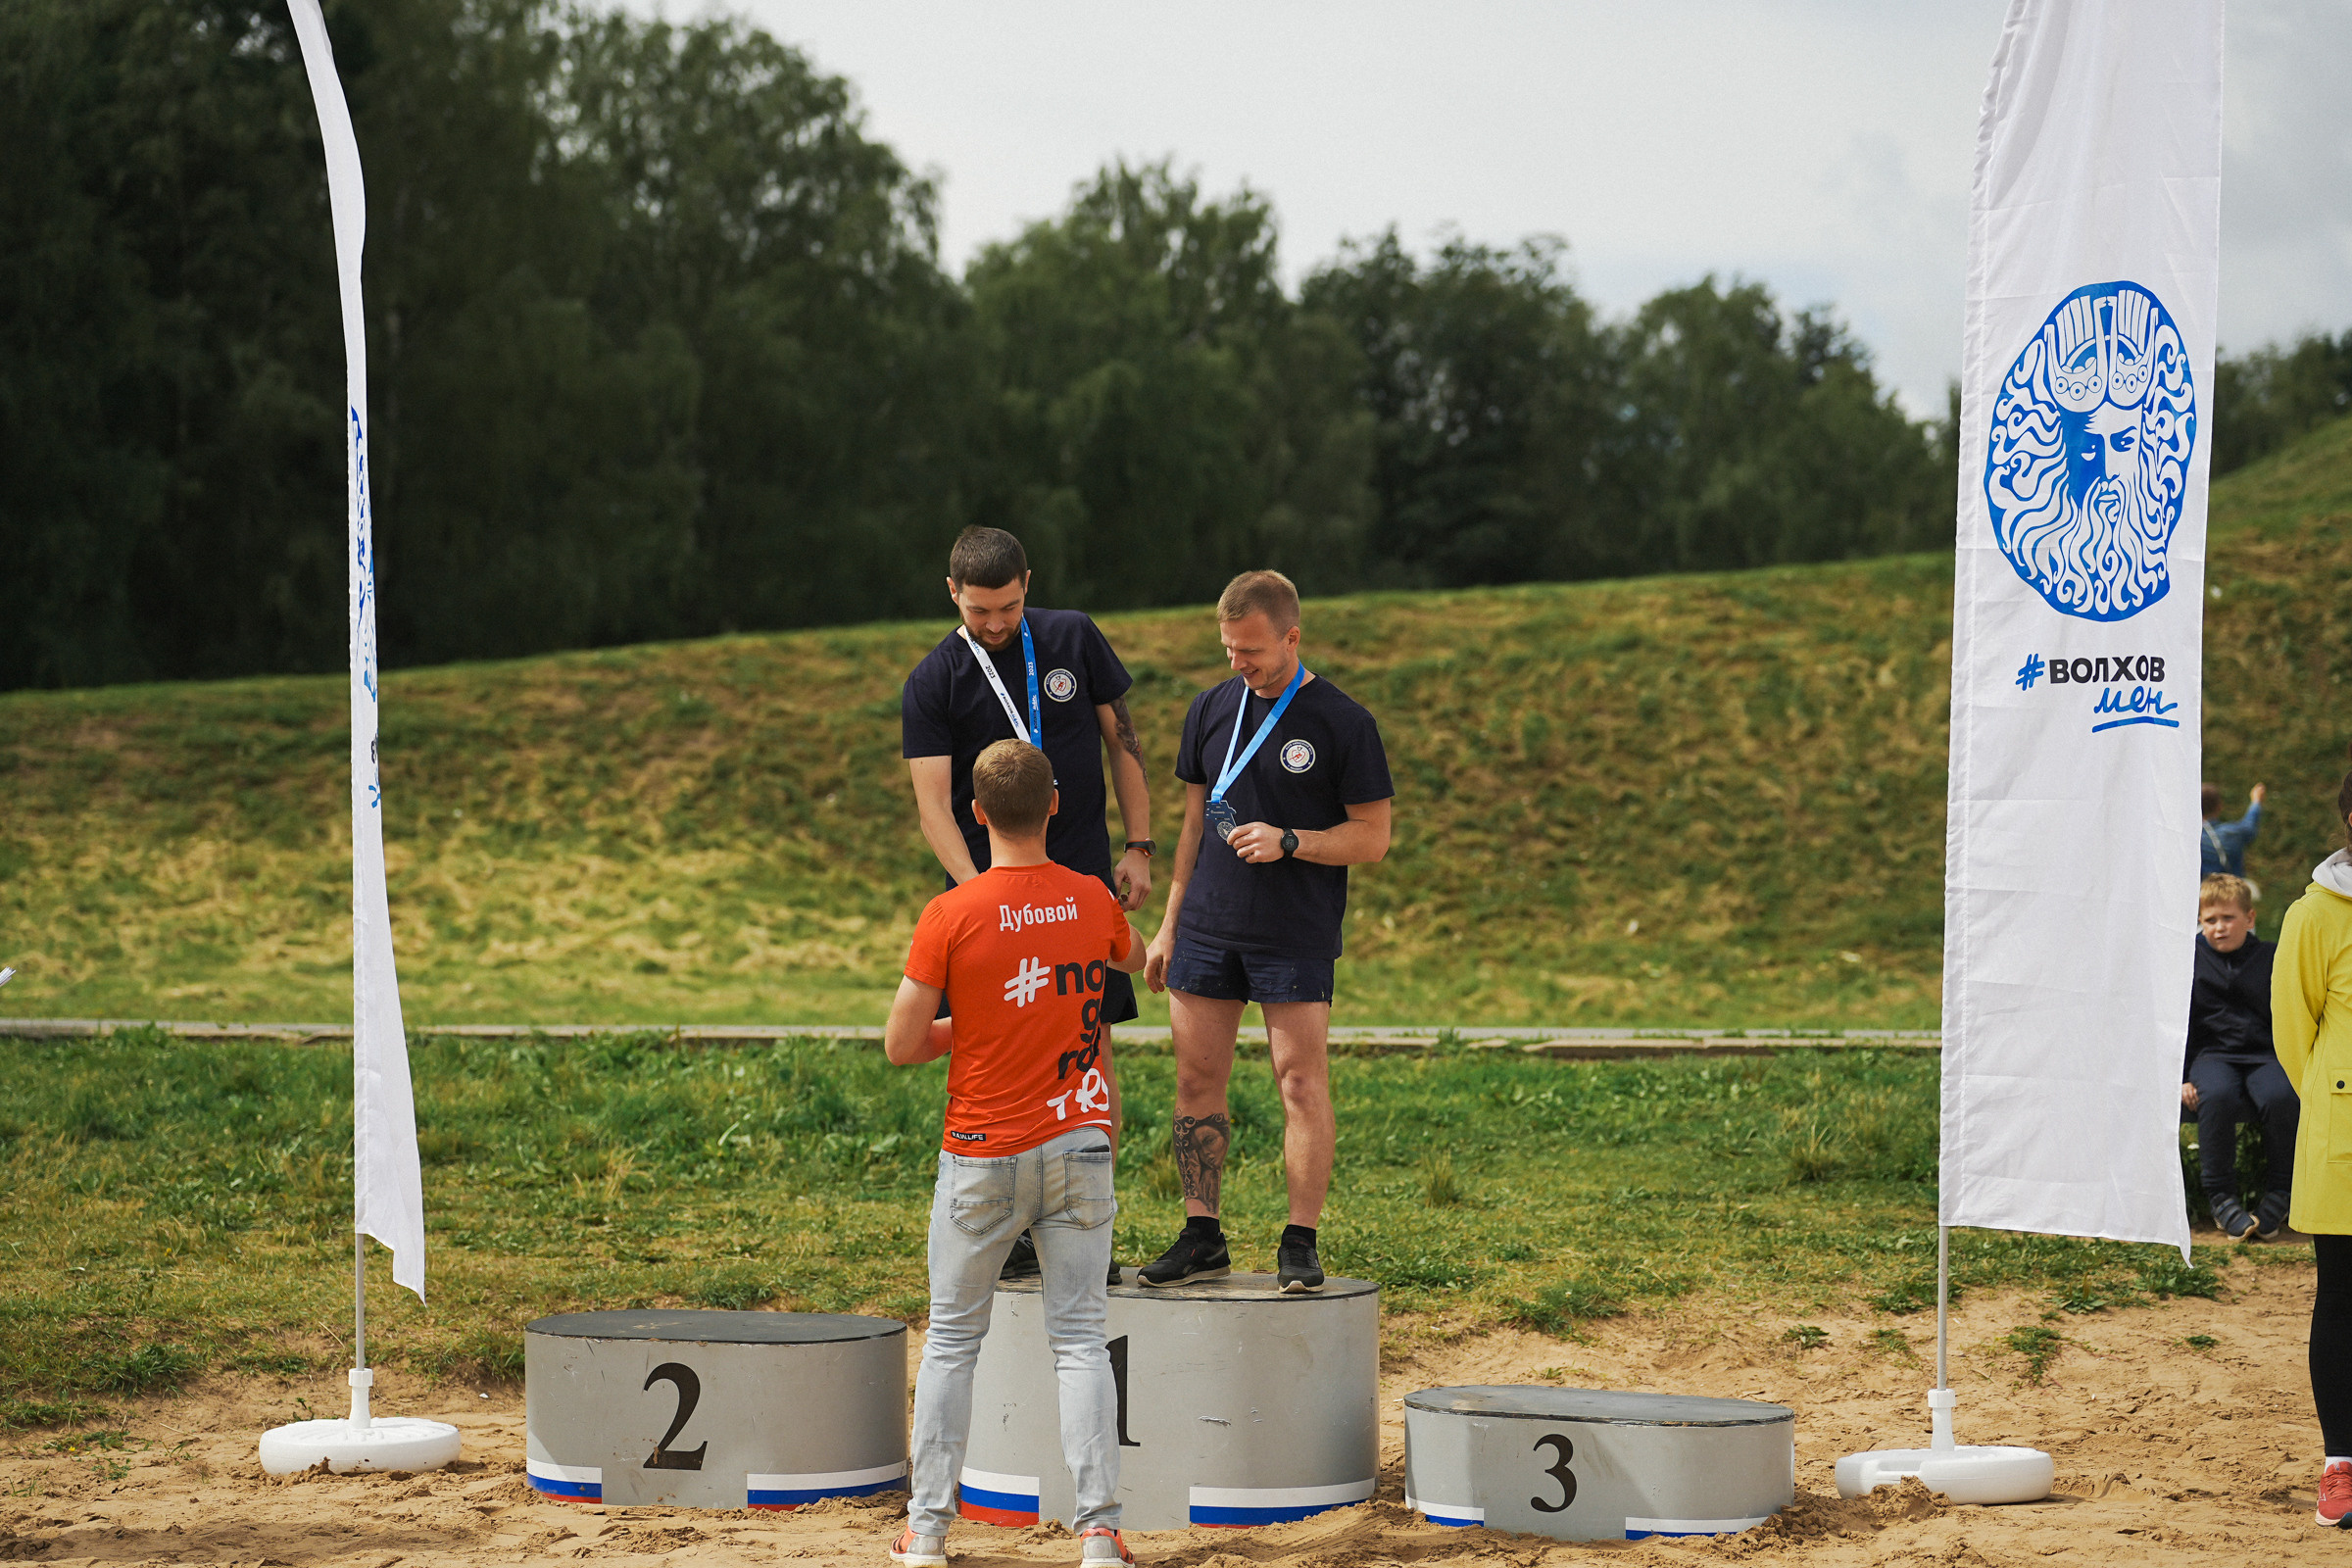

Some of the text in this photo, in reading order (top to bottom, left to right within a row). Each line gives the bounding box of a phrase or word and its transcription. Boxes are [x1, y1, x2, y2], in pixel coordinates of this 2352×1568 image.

[985, 664, 996, 679] 2023
[2016, 654, 2166, 691] #ВОЛХОВ
[999, 896, 1078, 933] Дубовой
[1004, 956, 1108, 1007] #no
[643, 1361, 709, 1471] 2
[1104, 1335, 1141, 1447] 1
[1530, 1434, 1578, 1513] 3
